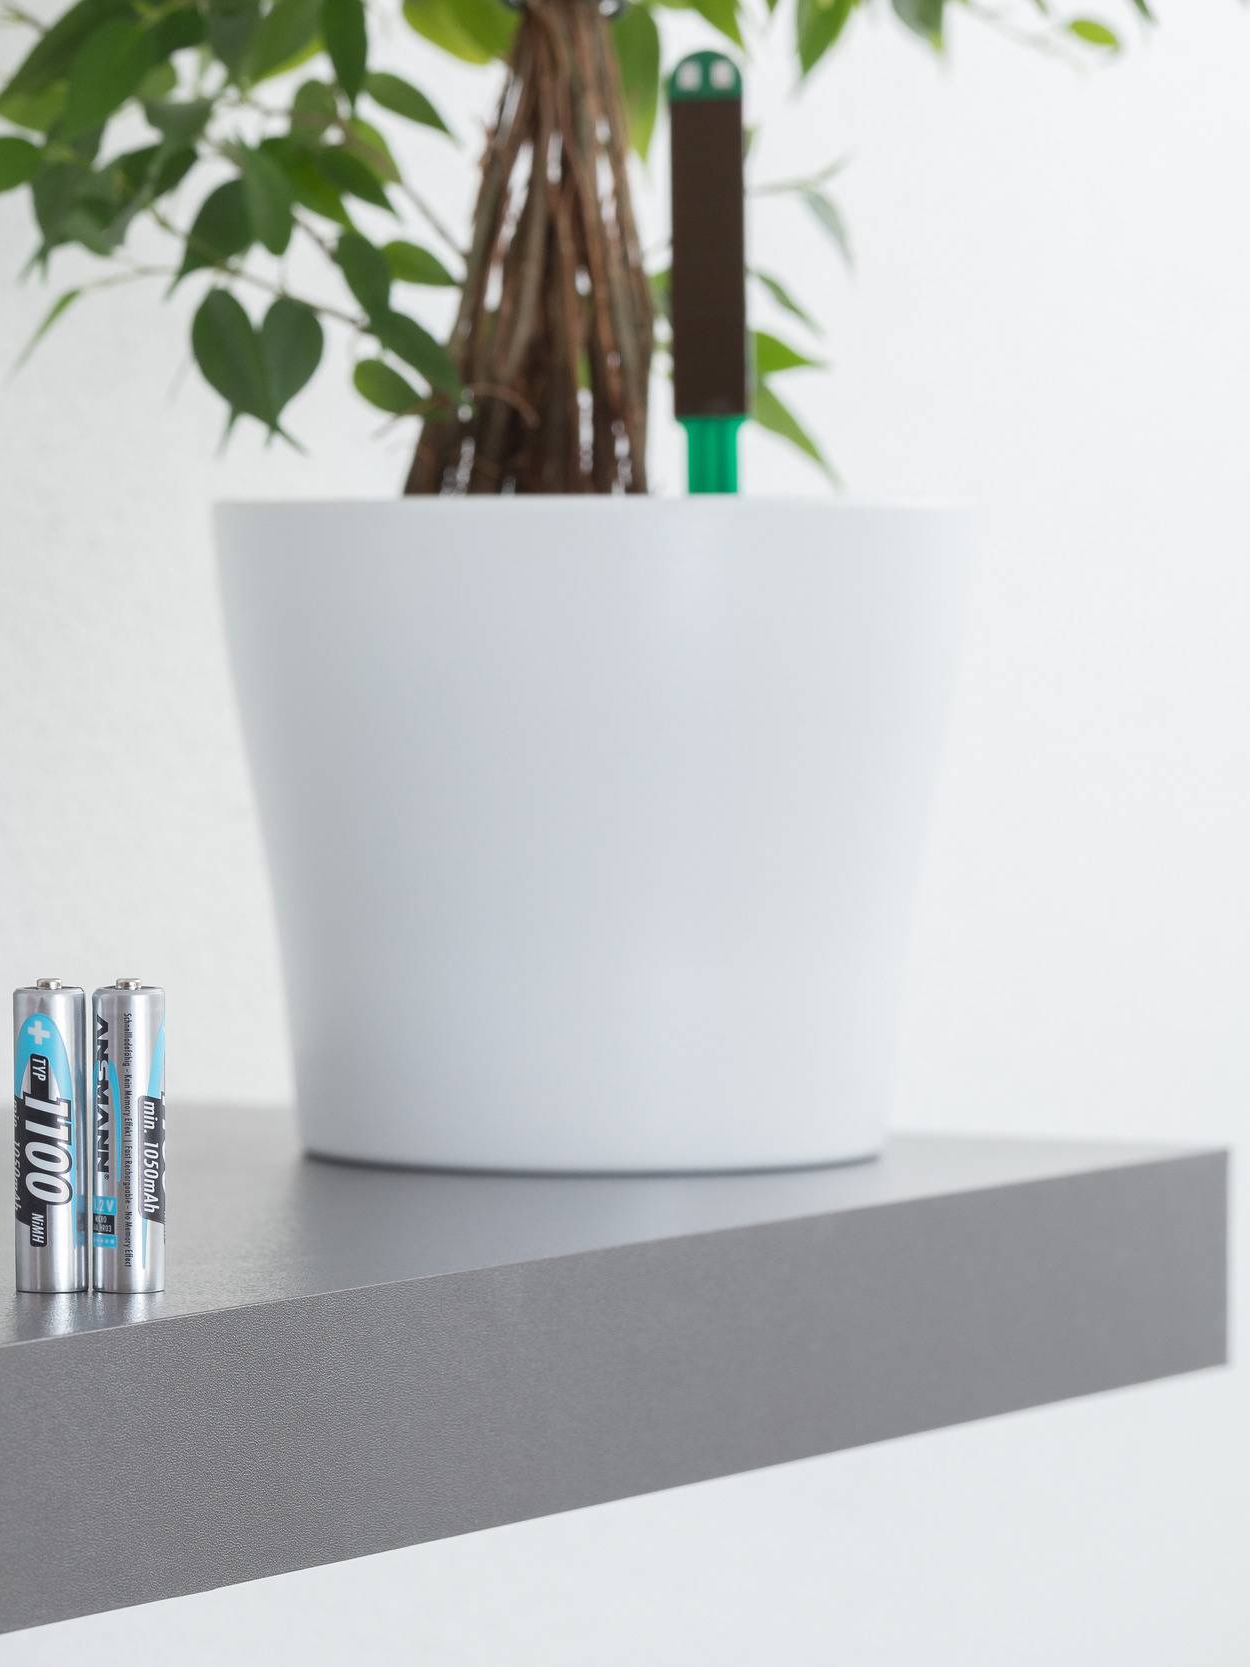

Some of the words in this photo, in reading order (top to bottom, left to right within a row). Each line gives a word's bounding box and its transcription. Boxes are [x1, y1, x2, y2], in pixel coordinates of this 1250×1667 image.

[32, 1058, 47, 1082] TYP
[124, 1074, 132, 1090] Kein
[123, 1090, 132, 1118] Memory
[143, 1100, 158, 1133] min.
[24, 1095, 73, 1204] 1100
[143, 1141, 160, 1214] 1050mAh
[31, 1212, 45, 1244] NiMH
[124, 1211, 133, 1221] No
[123, 1222, 133, 1248] Memory
